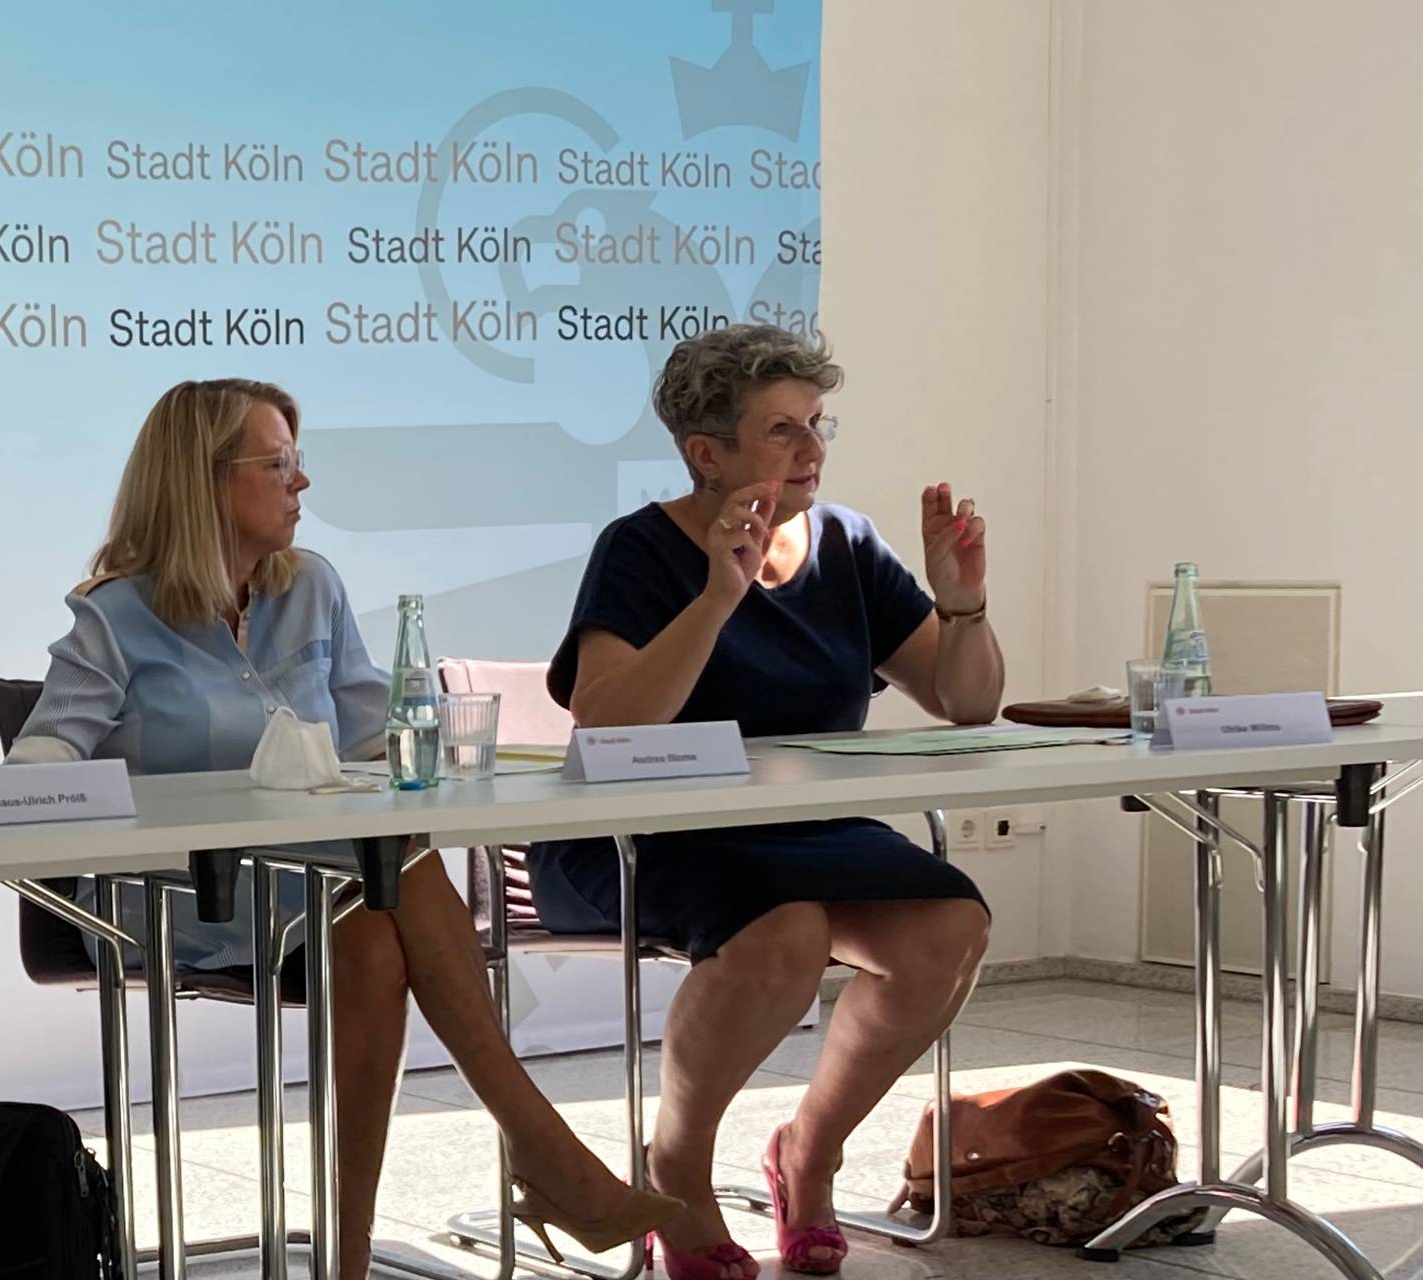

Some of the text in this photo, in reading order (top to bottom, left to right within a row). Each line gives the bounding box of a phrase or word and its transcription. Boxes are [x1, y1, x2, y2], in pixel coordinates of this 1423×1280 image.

[106, 139, 211, 181] Stadt
[223, 143, 304, 182] Köln
[324, 138, 440, 184] Stadt
[450, 139, 538, 184] Köln
[558, 147, 650, 187] Stadt
[660, 152, 731, 189] Köln
[96, 218, 217, 265] Stadt
[231, 220, 323, 265] Köln
[347, 226, 445, 264] Stadt
[457, 226, 531, 263] Köln
[554, 219, 661, 265] Stadt
[674, 224, 755, 266] Köln
[109, 308, 213, 348] Stadt
[226, 308, 305, 346] Köln
[325, 301, 439, 345] Stadt
[451, 299, 538, 343] Köln
[557, 304, 649, 341] Stadt
